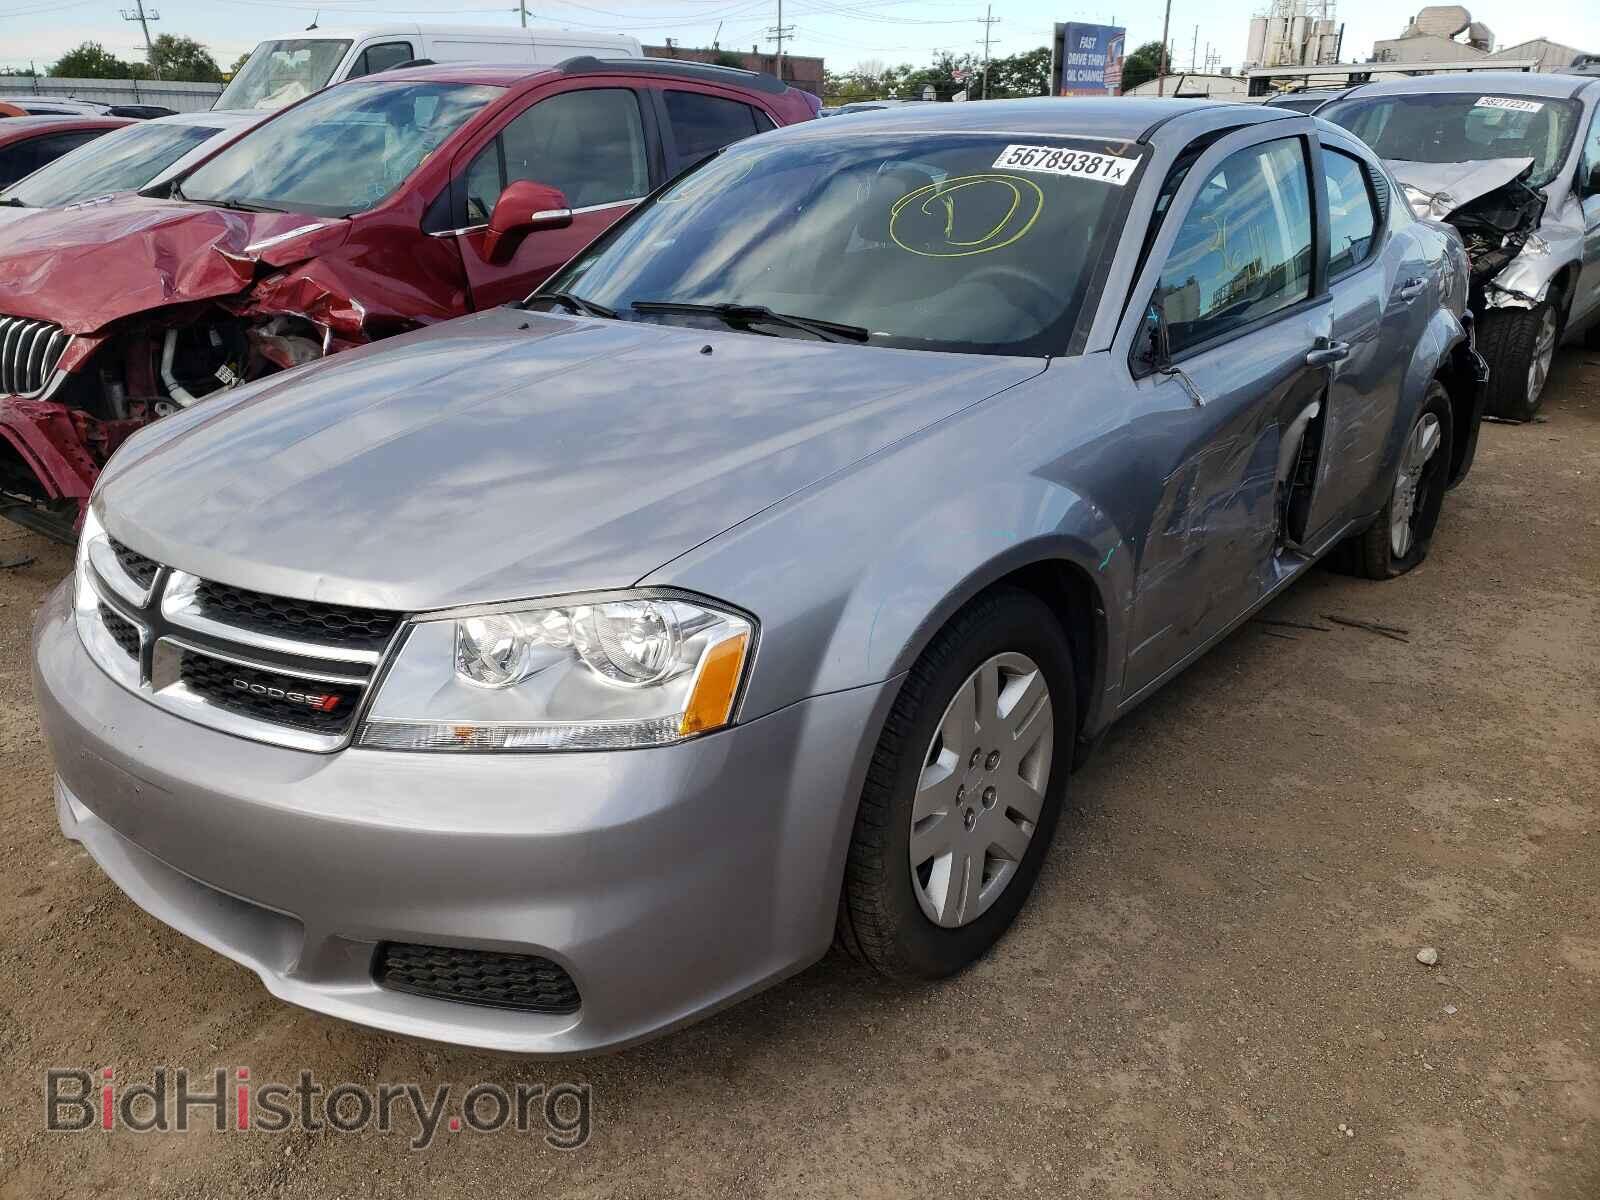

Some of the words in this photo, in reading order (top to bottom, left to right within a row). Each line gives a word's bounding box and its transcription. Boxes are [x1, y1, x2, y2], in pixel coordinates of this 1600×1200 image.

[1079, 36, 1097, 49] FAST
[1067, 53, 1087, 65] DRIVE
[1088, 54, 1106, 66] THRU
[1066, 69, 1077, 81] OIL
[1078, 70, 1105, 83] CHANGE
[232, 678, 324, 707] DODGE
